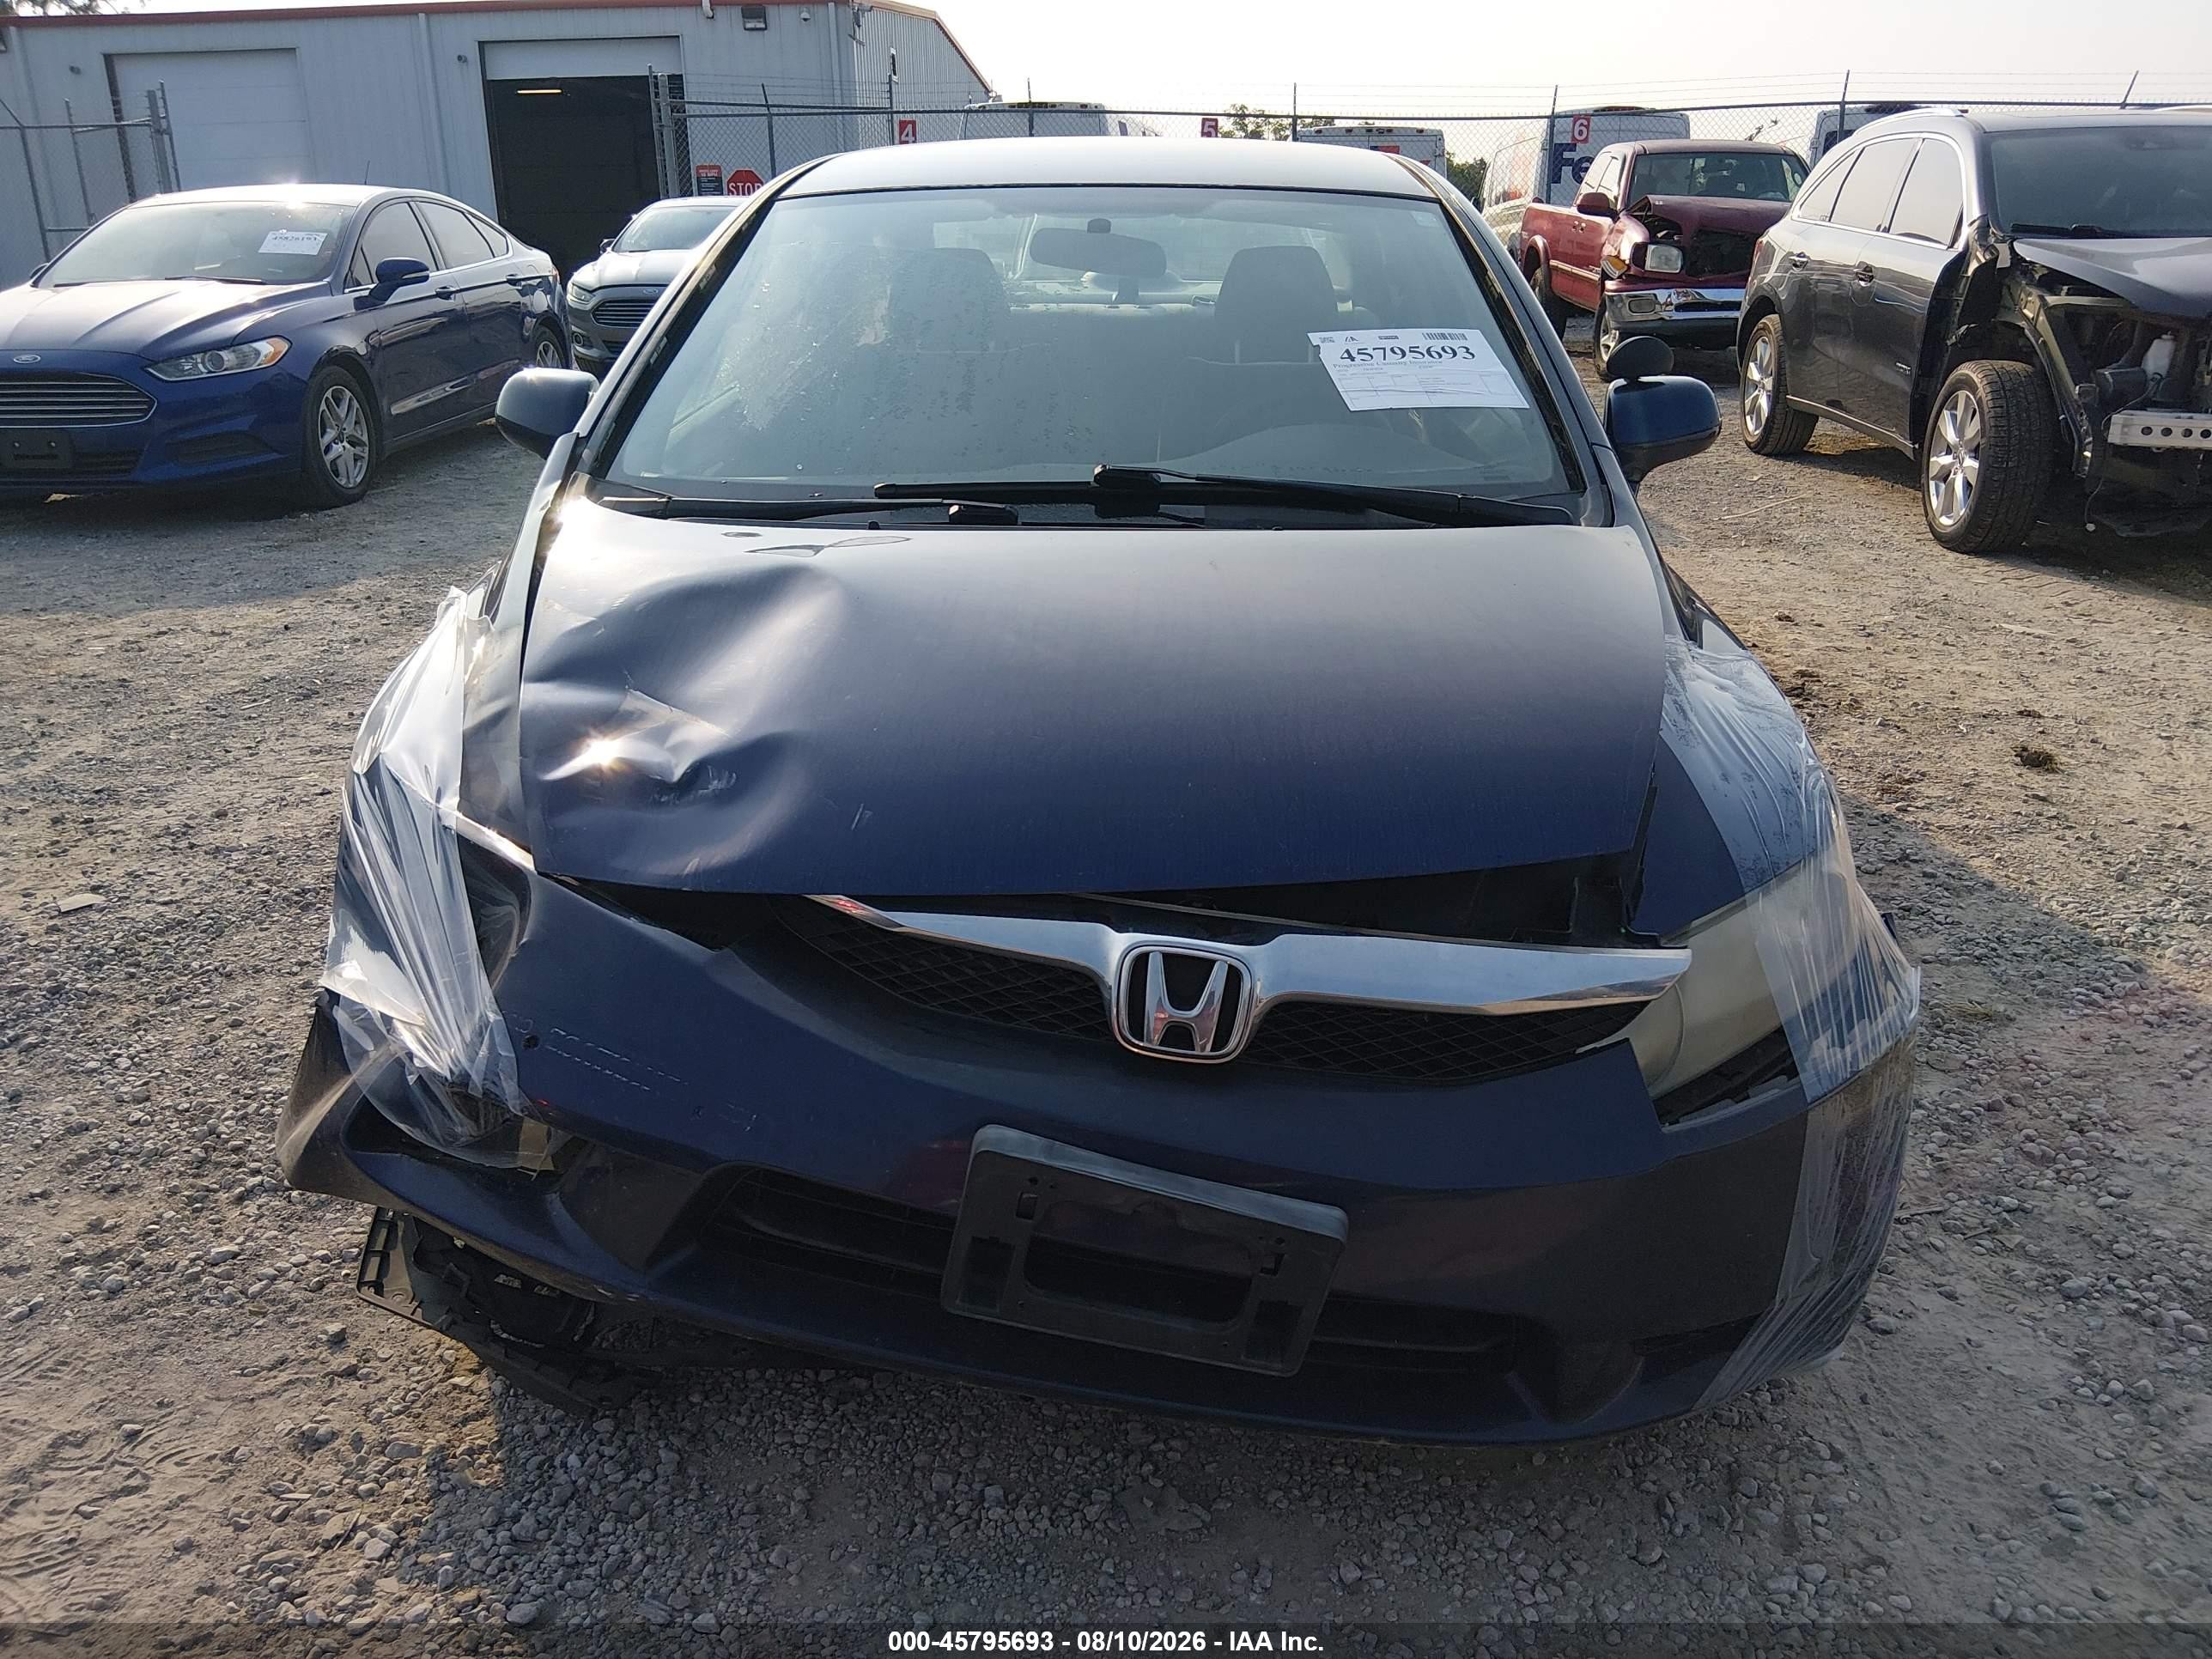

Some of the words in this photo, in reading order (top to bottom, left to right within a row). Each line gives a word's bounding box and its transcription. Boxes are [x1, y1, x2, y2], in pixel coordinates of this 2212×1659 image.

[901, 123, 915, 143] 4
[1203, 121, 1216, 137] 5
[1574, 118, 1588, 141] 6
[1340, 345, 1476, 362] 45795693
